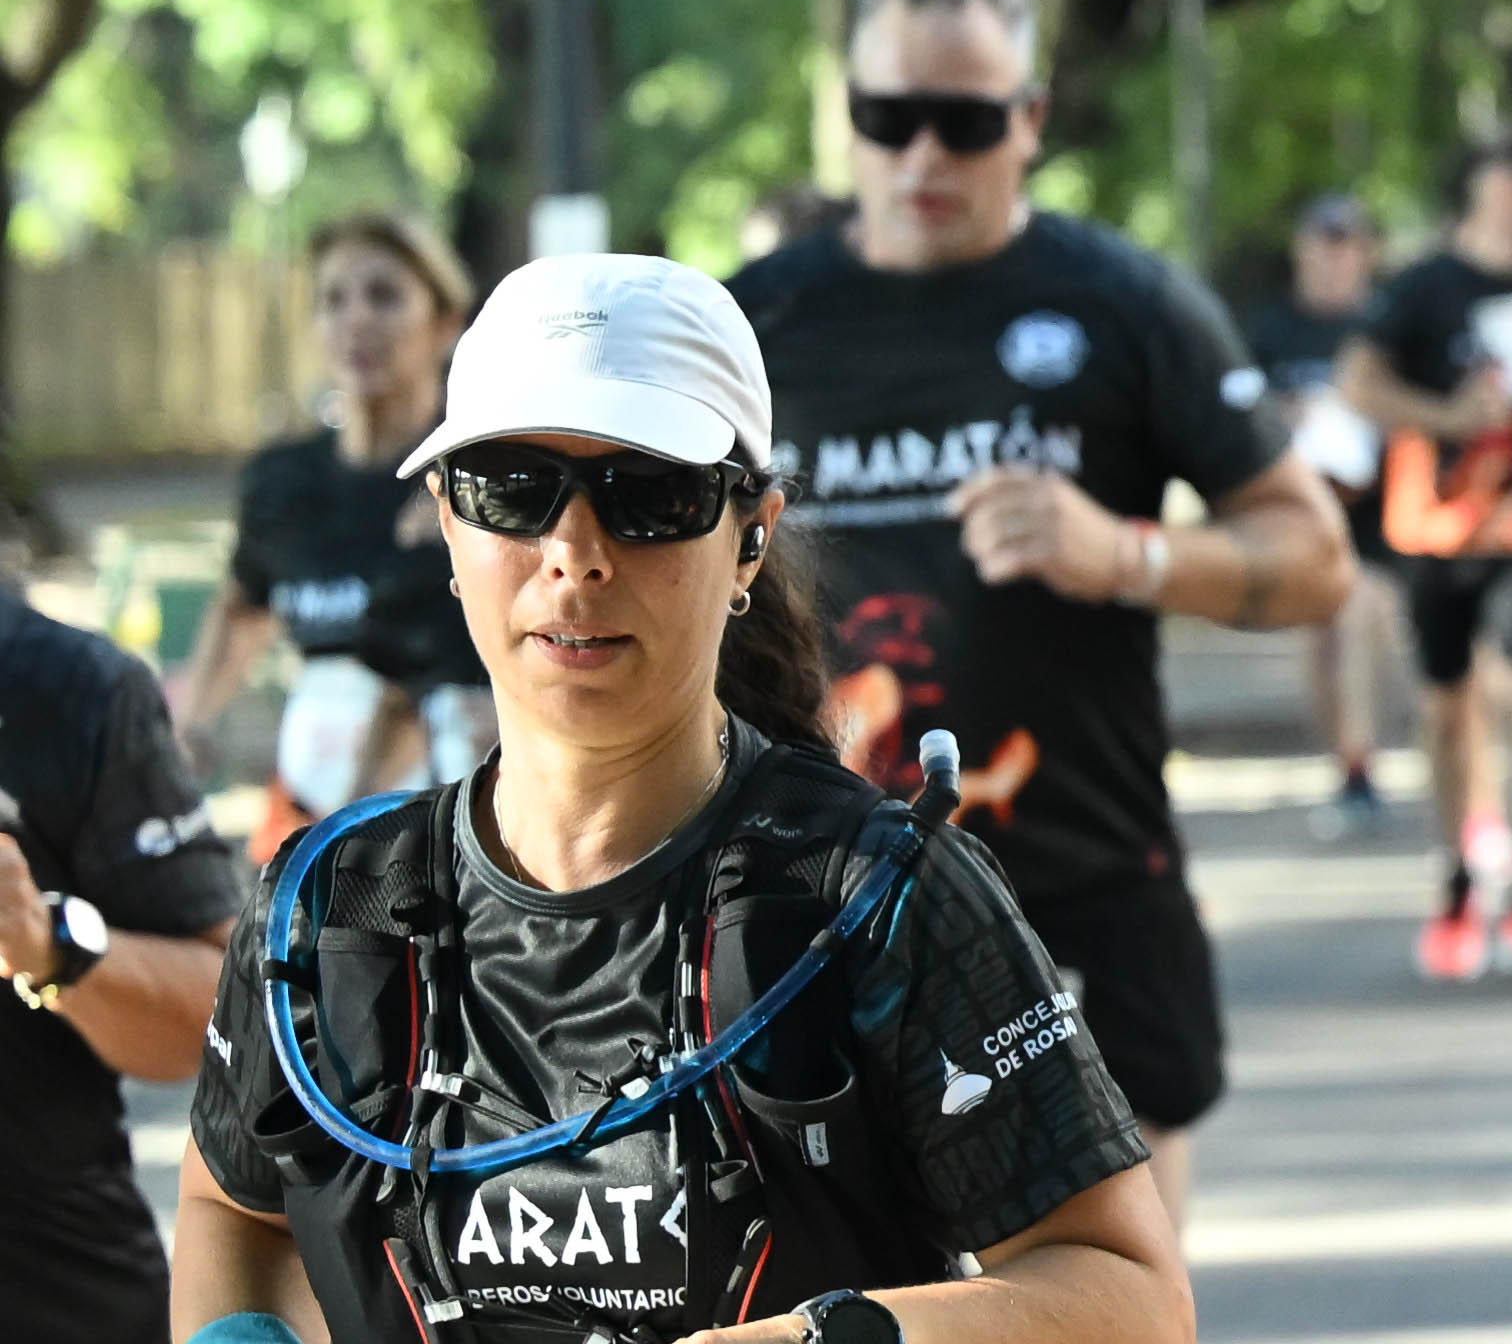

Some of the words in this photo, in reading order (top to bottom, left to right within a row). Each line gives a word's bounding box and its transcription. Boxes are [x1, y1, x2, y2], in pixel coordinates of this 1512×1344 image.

[995, 1049, 1023, 1079] DE
[1023, 1016, 1077, 1060] ROSA
[452, 1185, 688, 1267] ARAT
